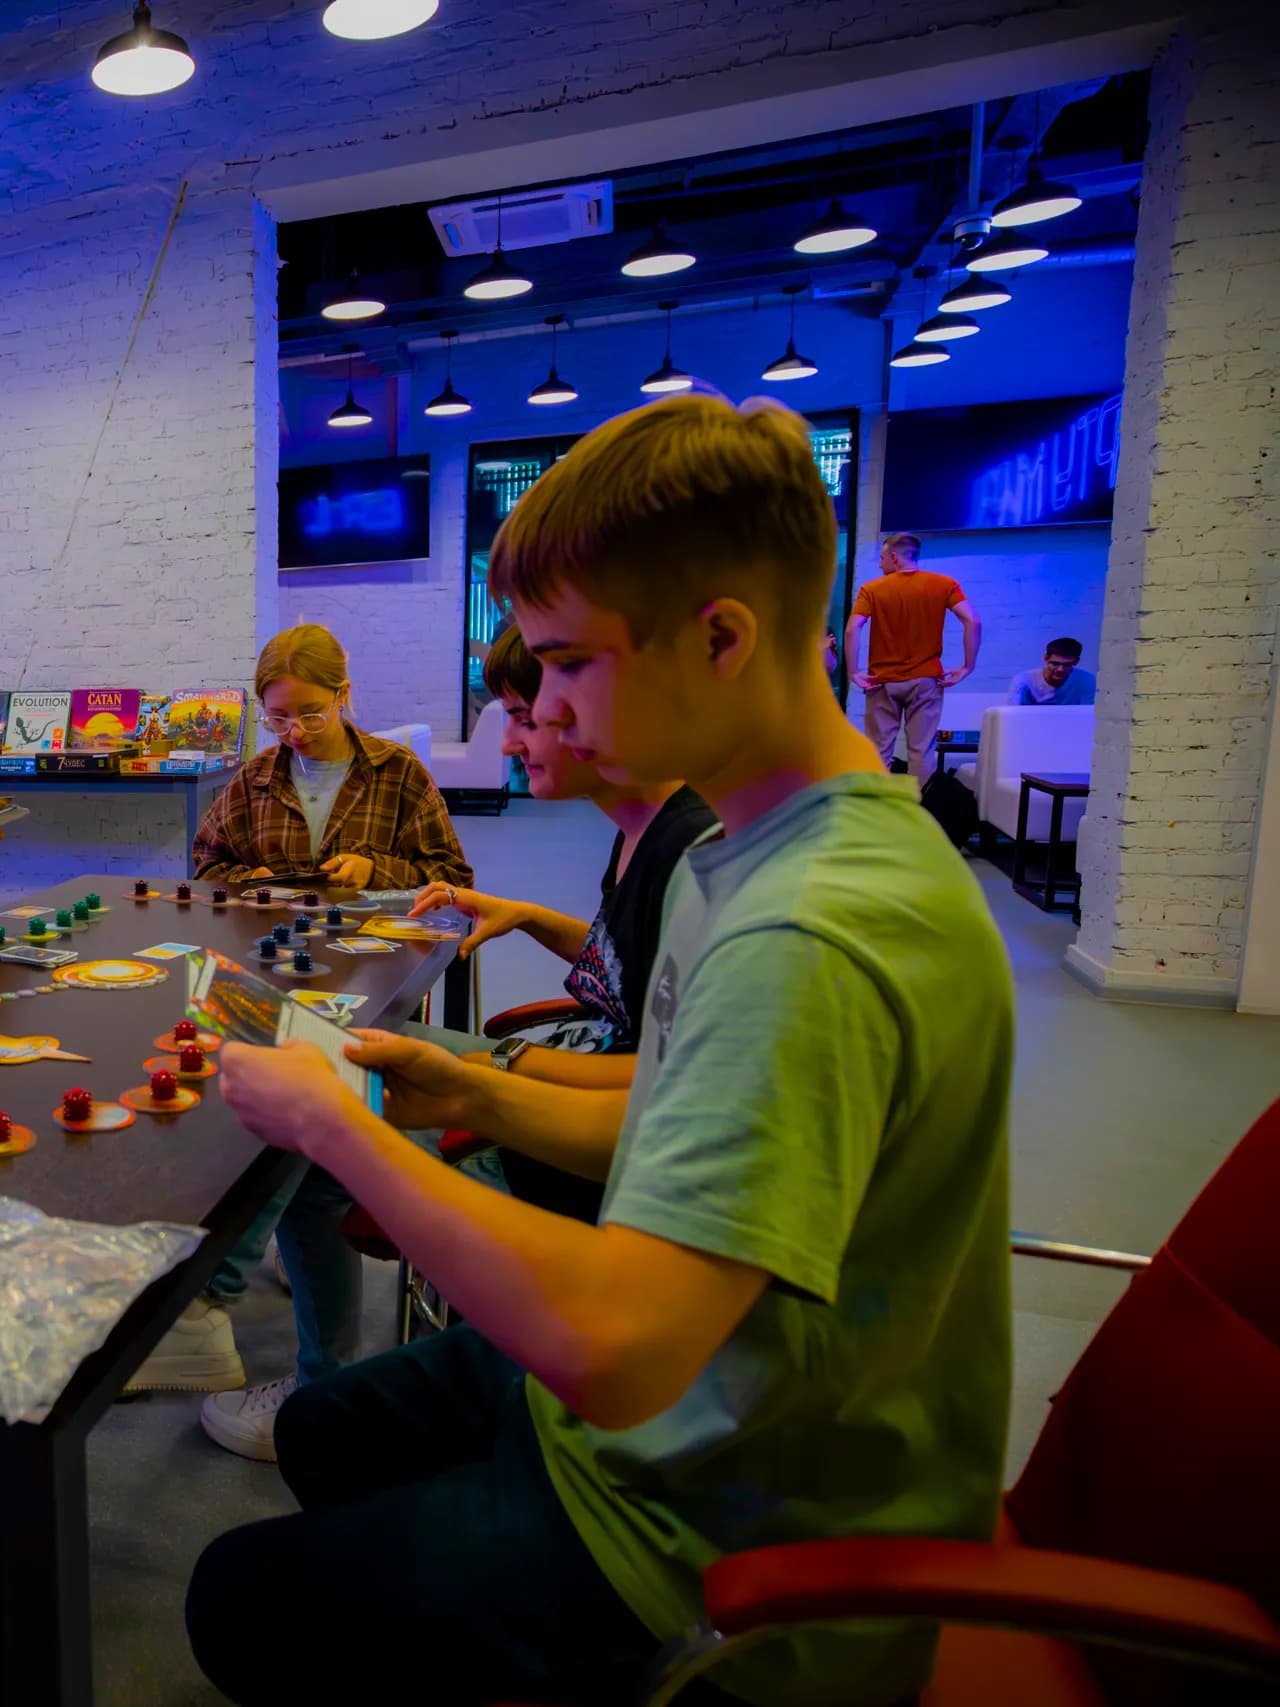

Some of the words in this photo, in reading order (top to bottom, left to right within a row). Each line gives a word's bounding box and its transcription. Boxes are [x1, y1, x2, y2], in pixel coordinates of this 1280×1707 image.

[12, 697, 68, 708] EVOLUTION
[87, 693, 122, 705] CATAN
[57, 757, 66, 770] 7
[64, 760, 86, 768] ЧУДЕС
